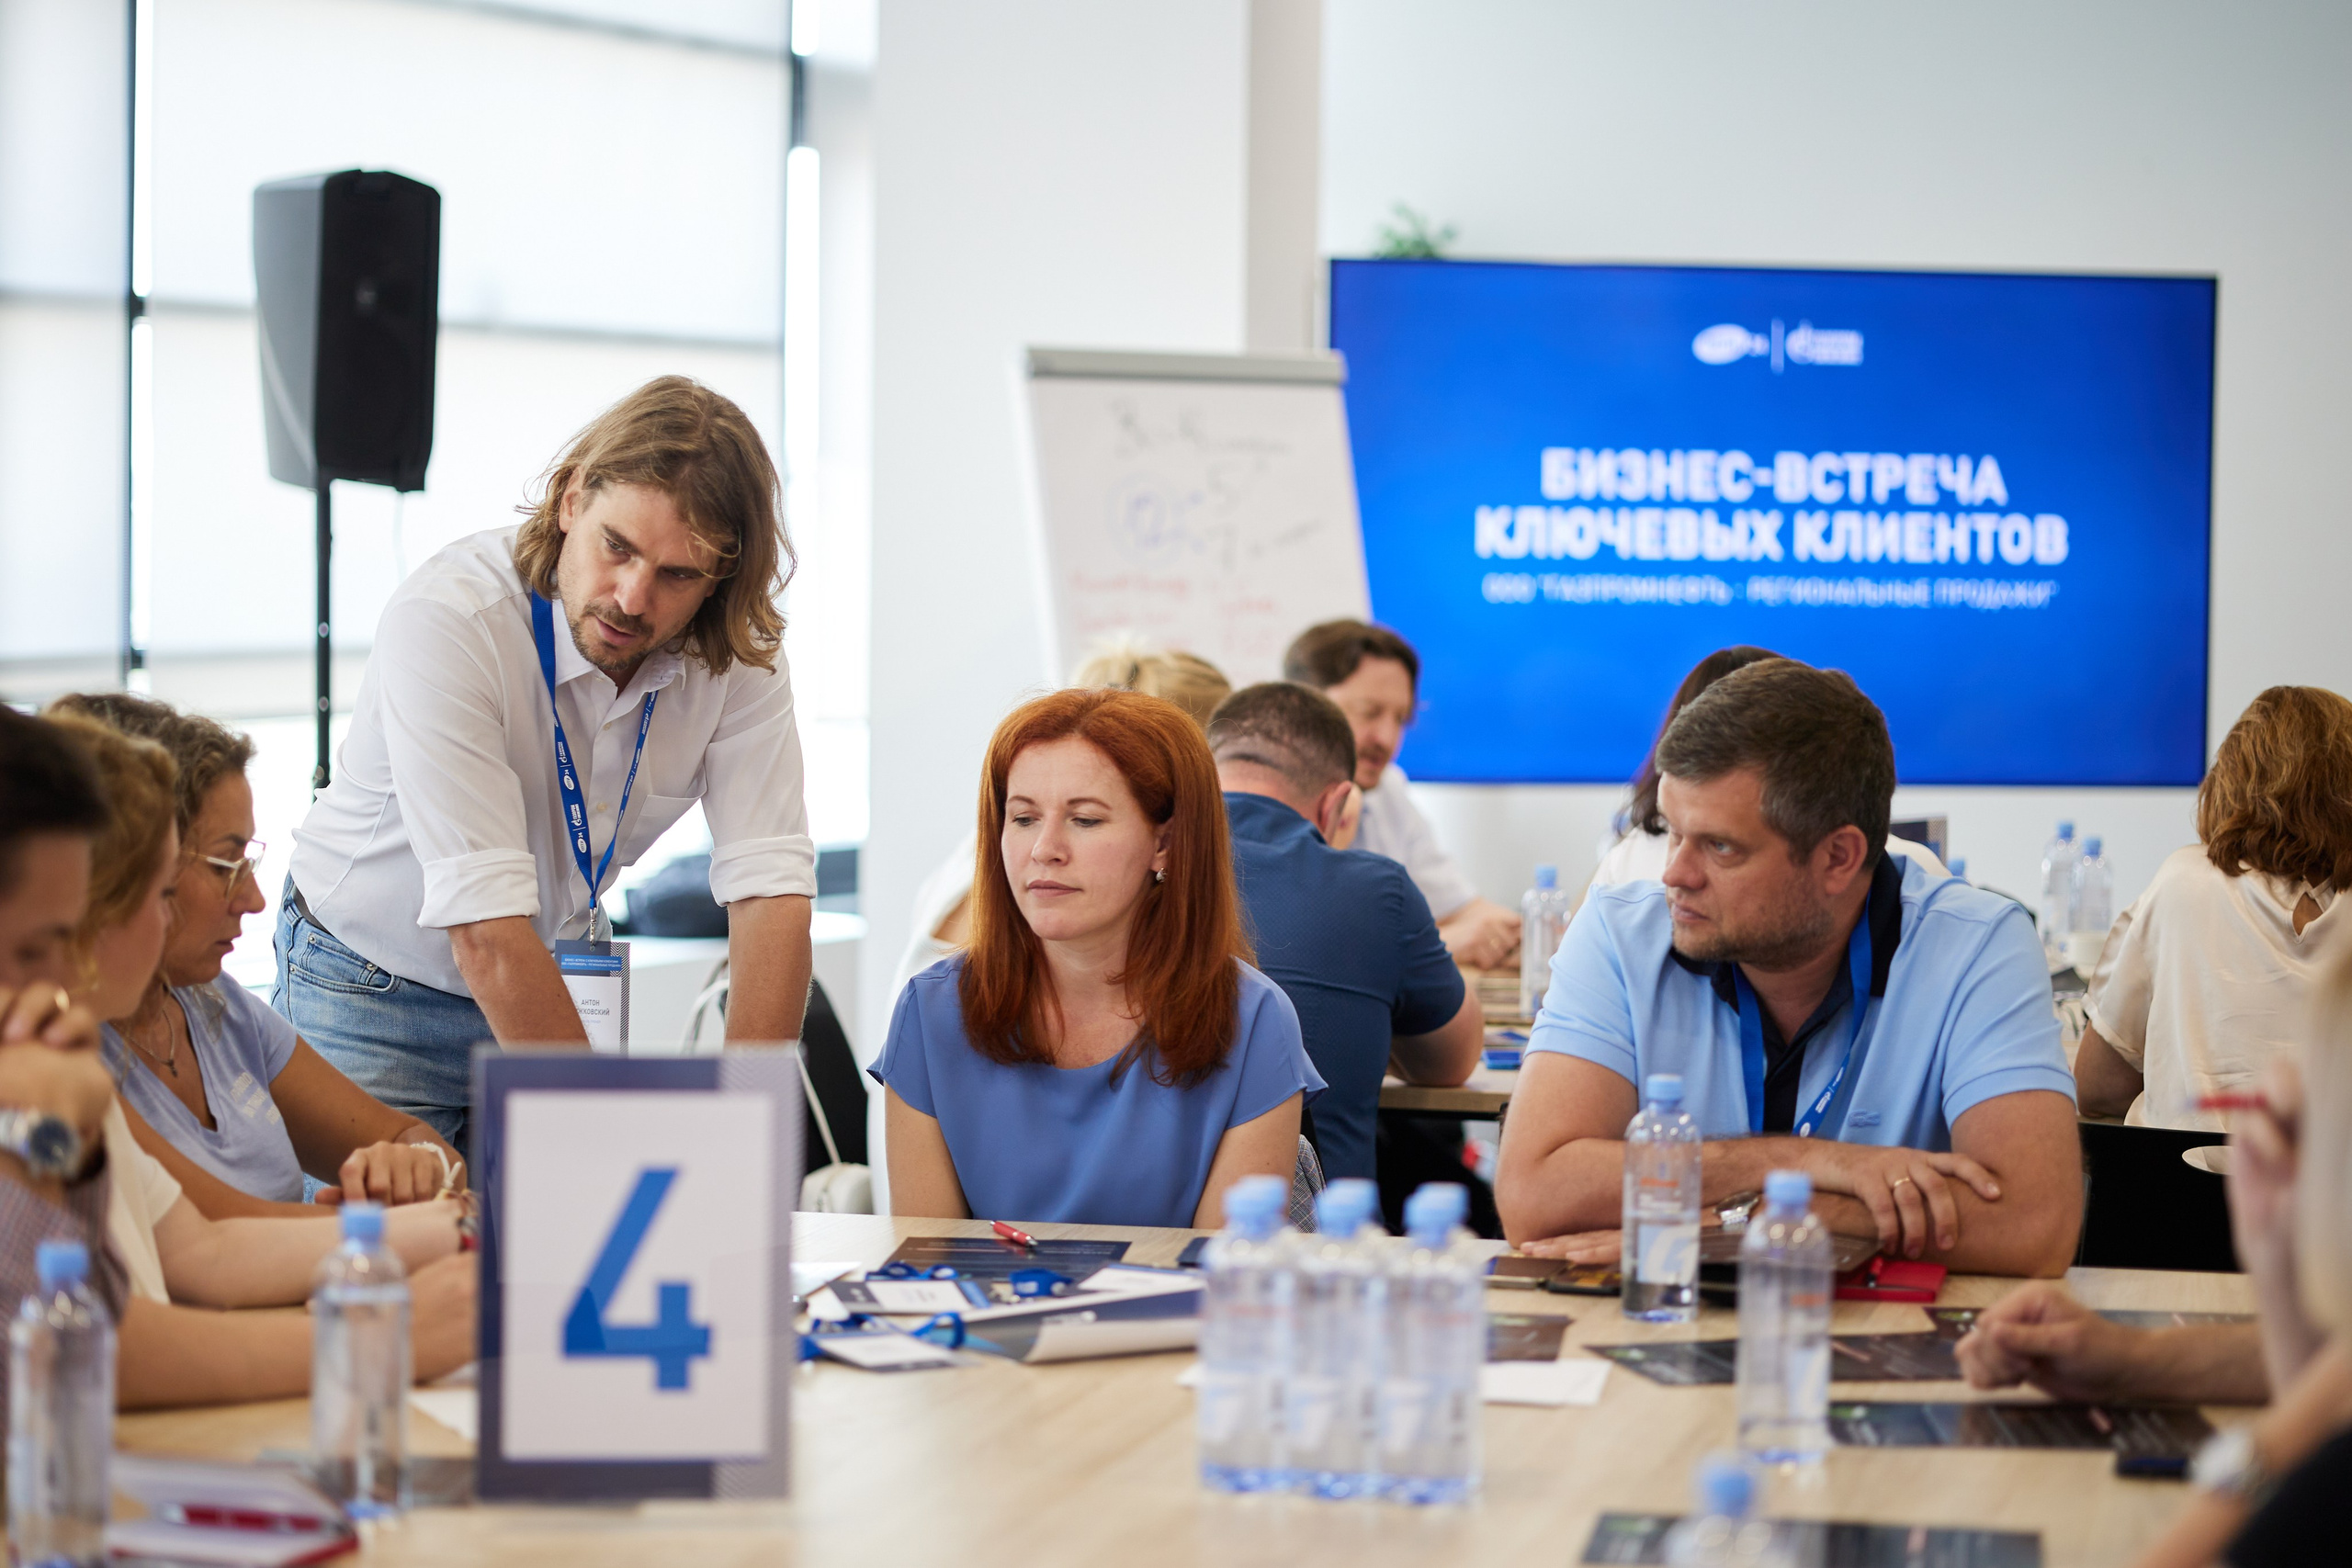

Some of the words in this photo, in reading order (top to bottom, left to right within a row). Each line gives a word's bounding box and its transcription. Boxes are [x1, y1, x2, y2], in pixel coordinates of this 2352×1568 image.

[1541, 447, 2008, 506] БИЗНЕС-ВСТРЕЧА
[1475, 505, 1784, 561] КЛЮЧЕВЫХ
[1793, 510, 2069, 566] КЛИЕНТОВ
[1481, 572, 1537, 604] ООО
[562, 1166, 710, 1390] 4
